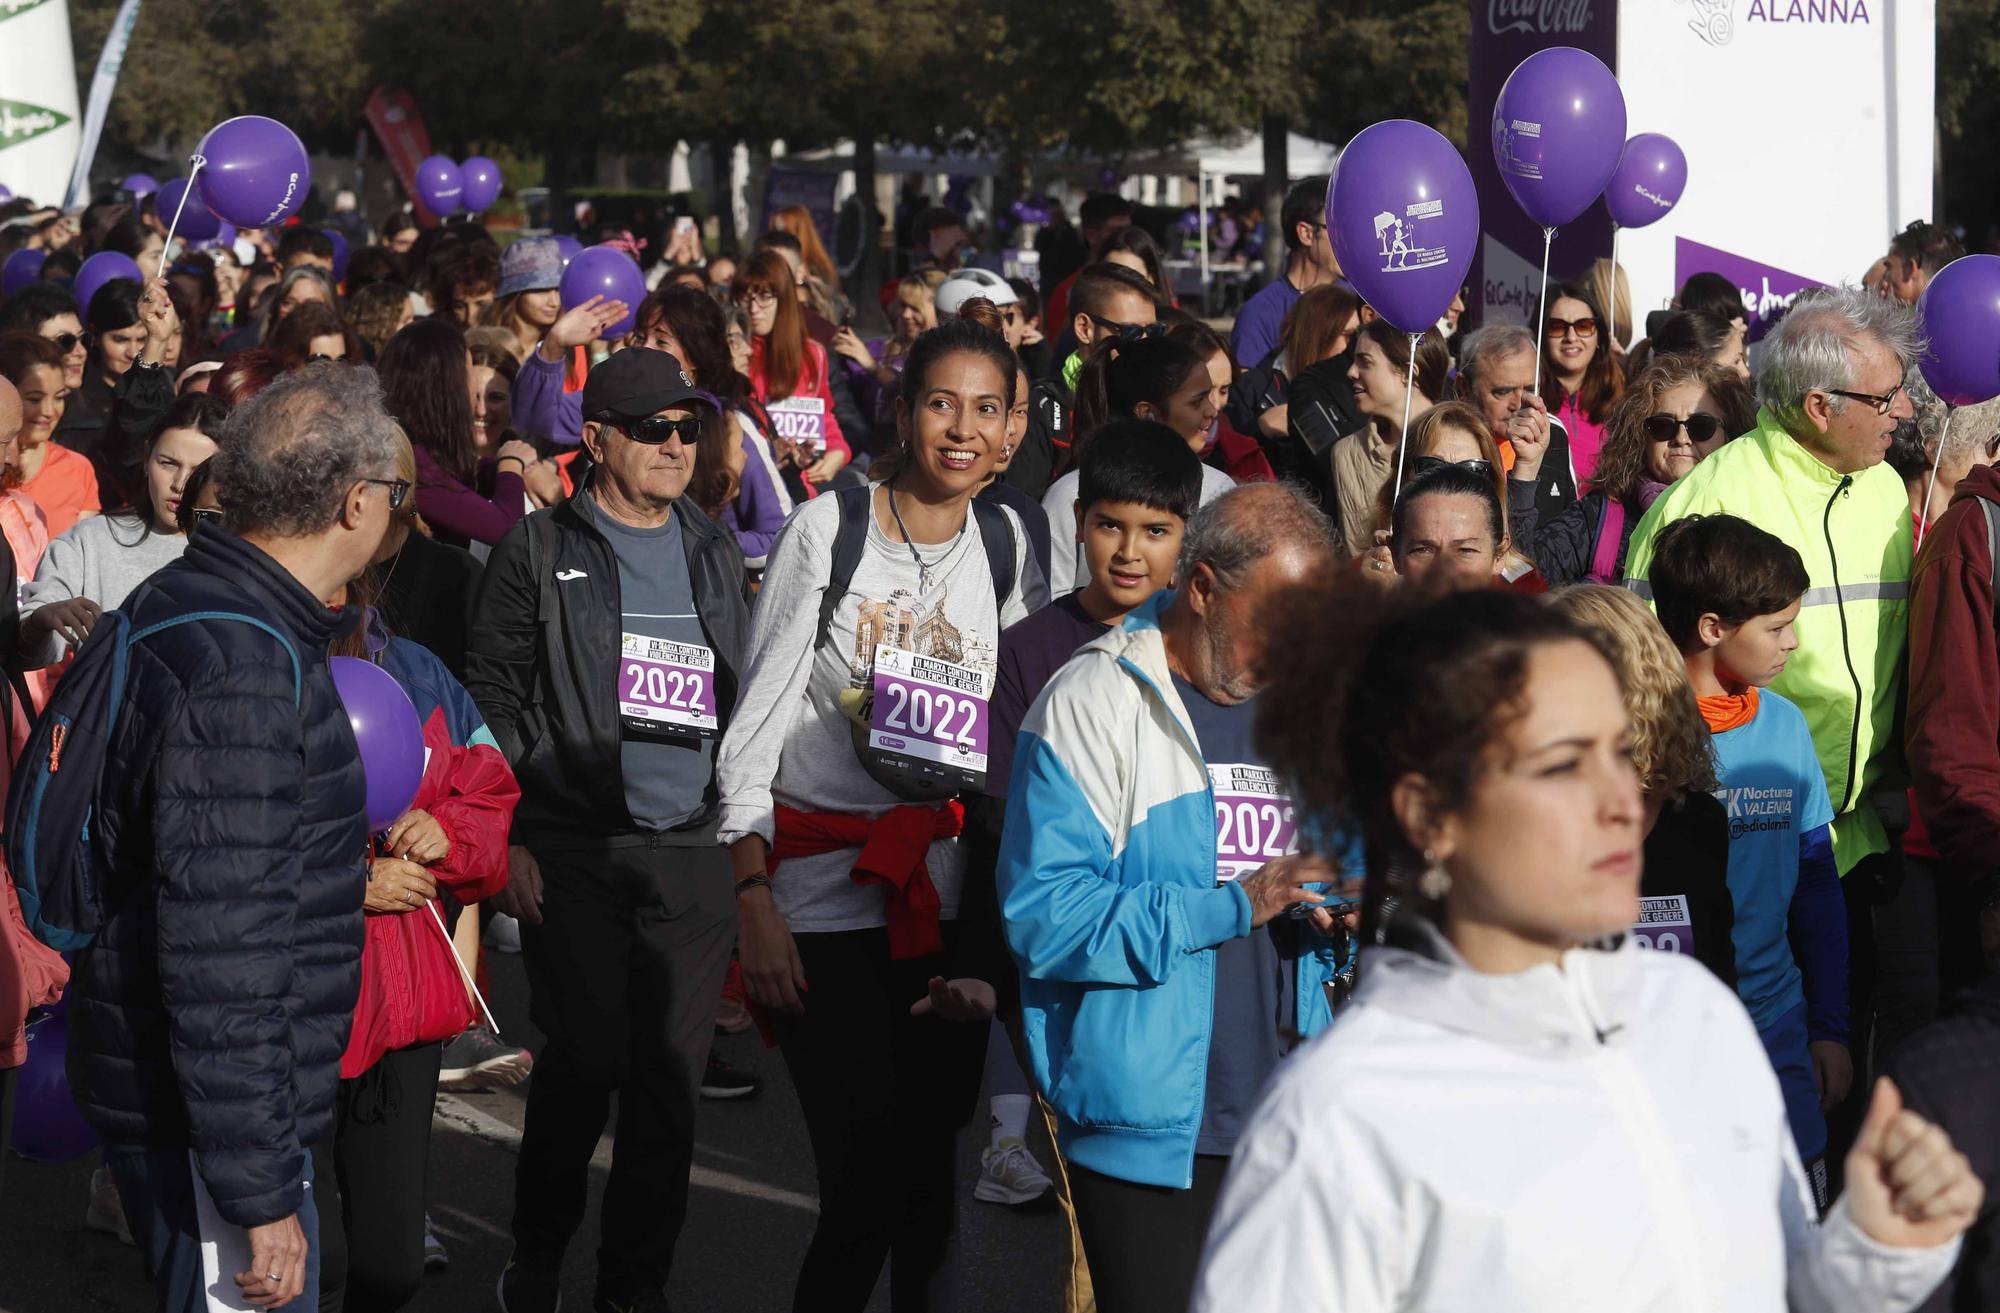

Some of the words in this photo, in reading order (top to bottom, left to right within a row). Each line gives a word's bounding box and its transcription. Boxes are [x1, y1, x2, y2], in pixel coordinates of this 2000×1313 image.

[1747, 0, 1869, 24] ALANNA
[772, 412, 820, 438] 2022
[678, 645, 701, 656] CONTRA
[701, 649, 710, 658] LA
[679, 655, 687, 664] DE
[914, 658, 921, 667] VI
[923, 659, 946, 673] MARXA
[947, 665, 972, 681] CONTRA
[972, 673, 981, 684] LA
[627, 664, 706, 710] 2022
[948, 677, 957, 687] DE
[884, 682, 977, 747] 2022
[1232, 767, 1243, 779] VI
[1242, 769, 1264, 781] MARXA
[1268, 784, 1278, 794] DE
[1712, 787, 1742, 818] K
[1216, 801, 1300, 856] 2022
[1640, 900, 1668, 910] ONTRA
[1668, 899, 1680, 909] LA
[1640, 912, 1652, 922] DE
